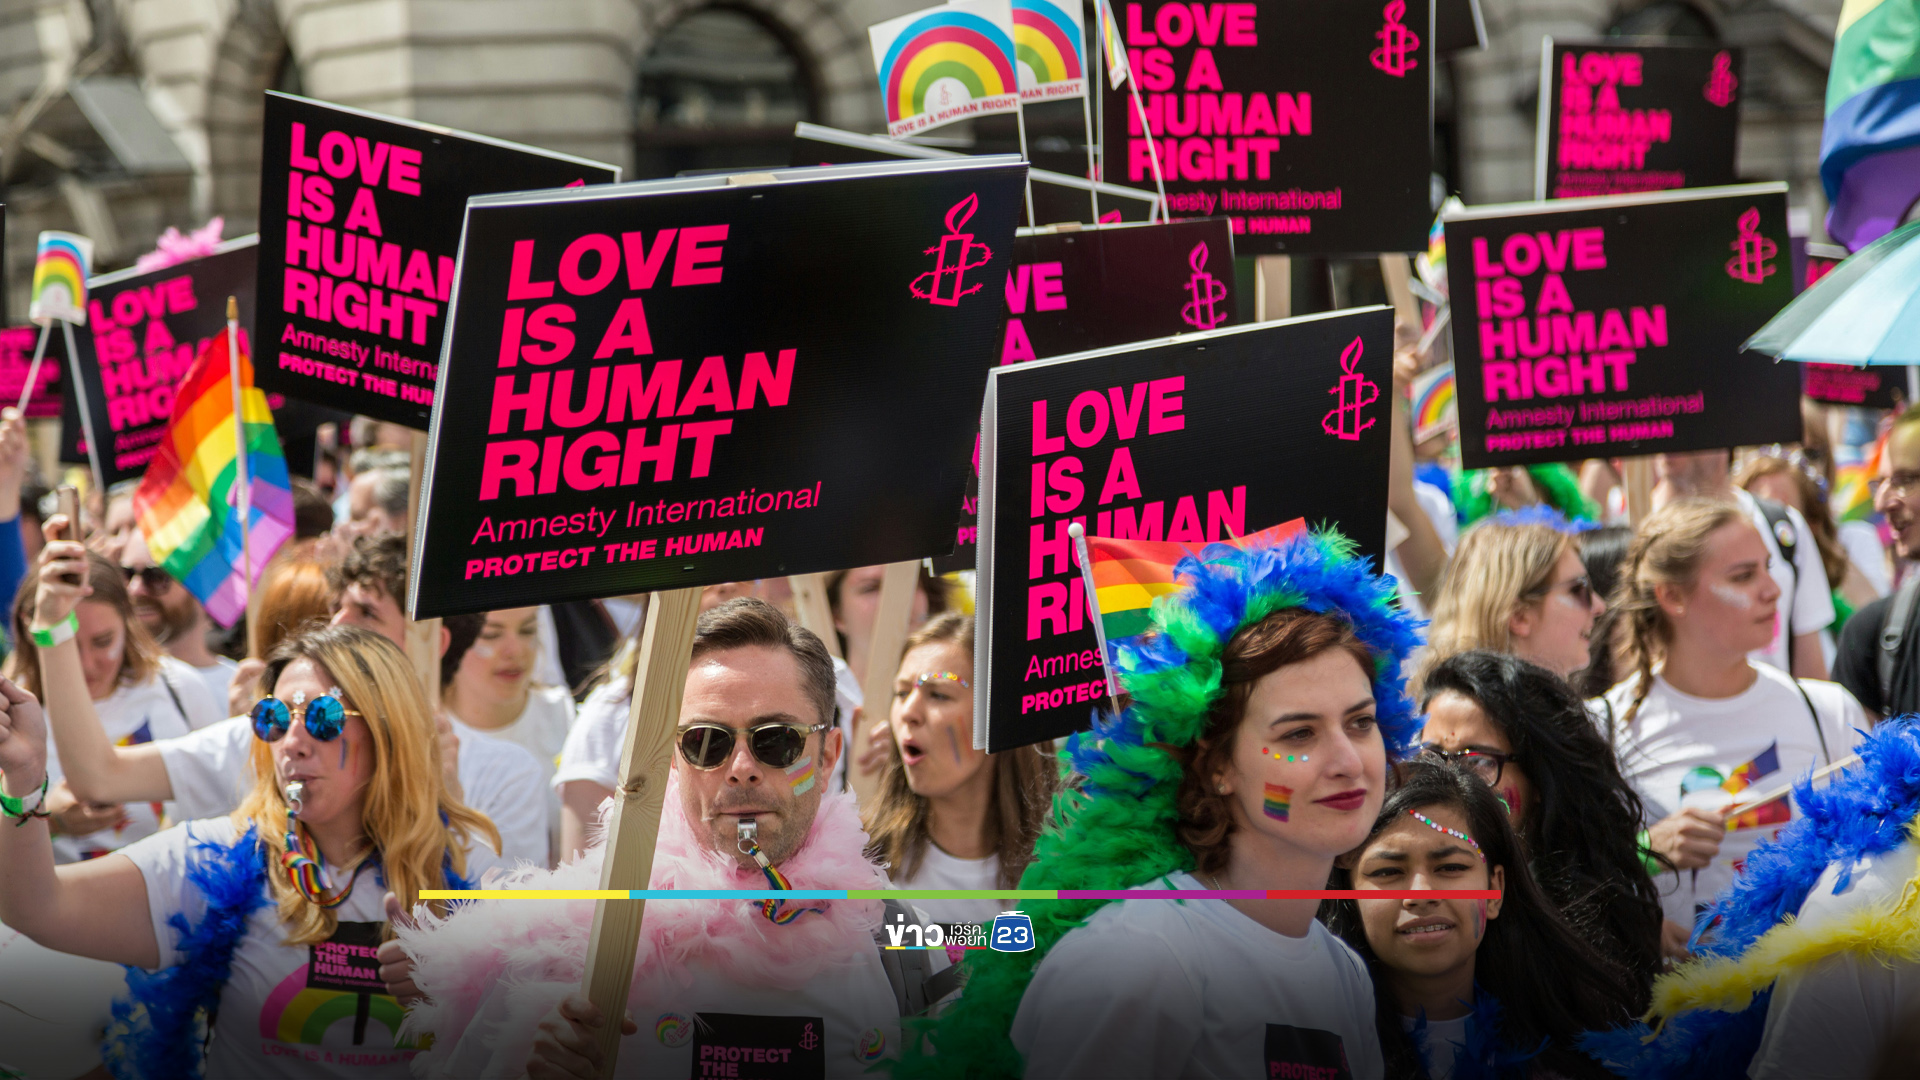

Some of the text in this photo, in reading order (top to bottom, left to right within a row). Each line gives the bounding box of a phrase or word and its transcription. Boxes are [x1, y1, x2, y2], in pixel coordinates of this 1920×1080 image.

[1126, 2, 1258, 47] LOVE
[1020, 83, 1081, 100] MAN RIGHT
[1127, 47, 1176, 92] IS
[1184, 47, 1224, 92] A
[1561, 52, 1644, 87] LOVE
[889, 97, 1018, 138] LOVE IS A HUMAN RIGHT
[1127, 92, 1312, 137] HUMAN
[289, 121, 423, 197] LOVE
[1127, 136, 1280, 182] RIGHT
[287, 170, 383, 237] IS A
[1164, 187, 1342, 216] nesty International
[1248, 216, 1311, 235] HUMAN
[507, 224, 730, 301] LOVE
[1472, 227, 1607, 279] LOVE
[88, 275, 197, 335] LOVE
[283, 267, 438, 346] RIGHT
[1004, 261, 1068, 314] VE
[1475, 272, 1574, 320] IS A
[95, 327, 137, 368] IS
[281, 323, 370, 368] Amnesty
[497, 298, 654, 369] IS A
[1000, 318, 1037, 366] A
[1478, 304, 1668, 361] HUMAN
[278, 352, 359, 387] PROTECT
[361, 373, 399, 398] THE
[488, 348, 798, 435] HUMAN
[1482, 350, 1636, 402] RIGHT
[1031, 375, 1185, 457] LOVE
[1485, 403, 1575, 430] Amnesty
[1578, 390, 1704, 423] International
[1485, 420, 1674, 453] PROTECT THE HUMAN
[479, 419, 734, 501] RIGHT
[1030, 446, 1143, 519] IS A
[471, 480, 822, 546] Amnesty International
[464, 527, 764, 580] PROTECT THE HUMAN
[313, 961, 377, 980] HUMAN
[314, 950, 349, 966] THE
[315, 941, 379, 959] PROTEC
[323, 1051, 335, 1064] A
[338, 1052, 399, 1067] HUMAN
[700, 1044, 792, 1064] PROTECT
[700, 1060, 739, 1077] THE
